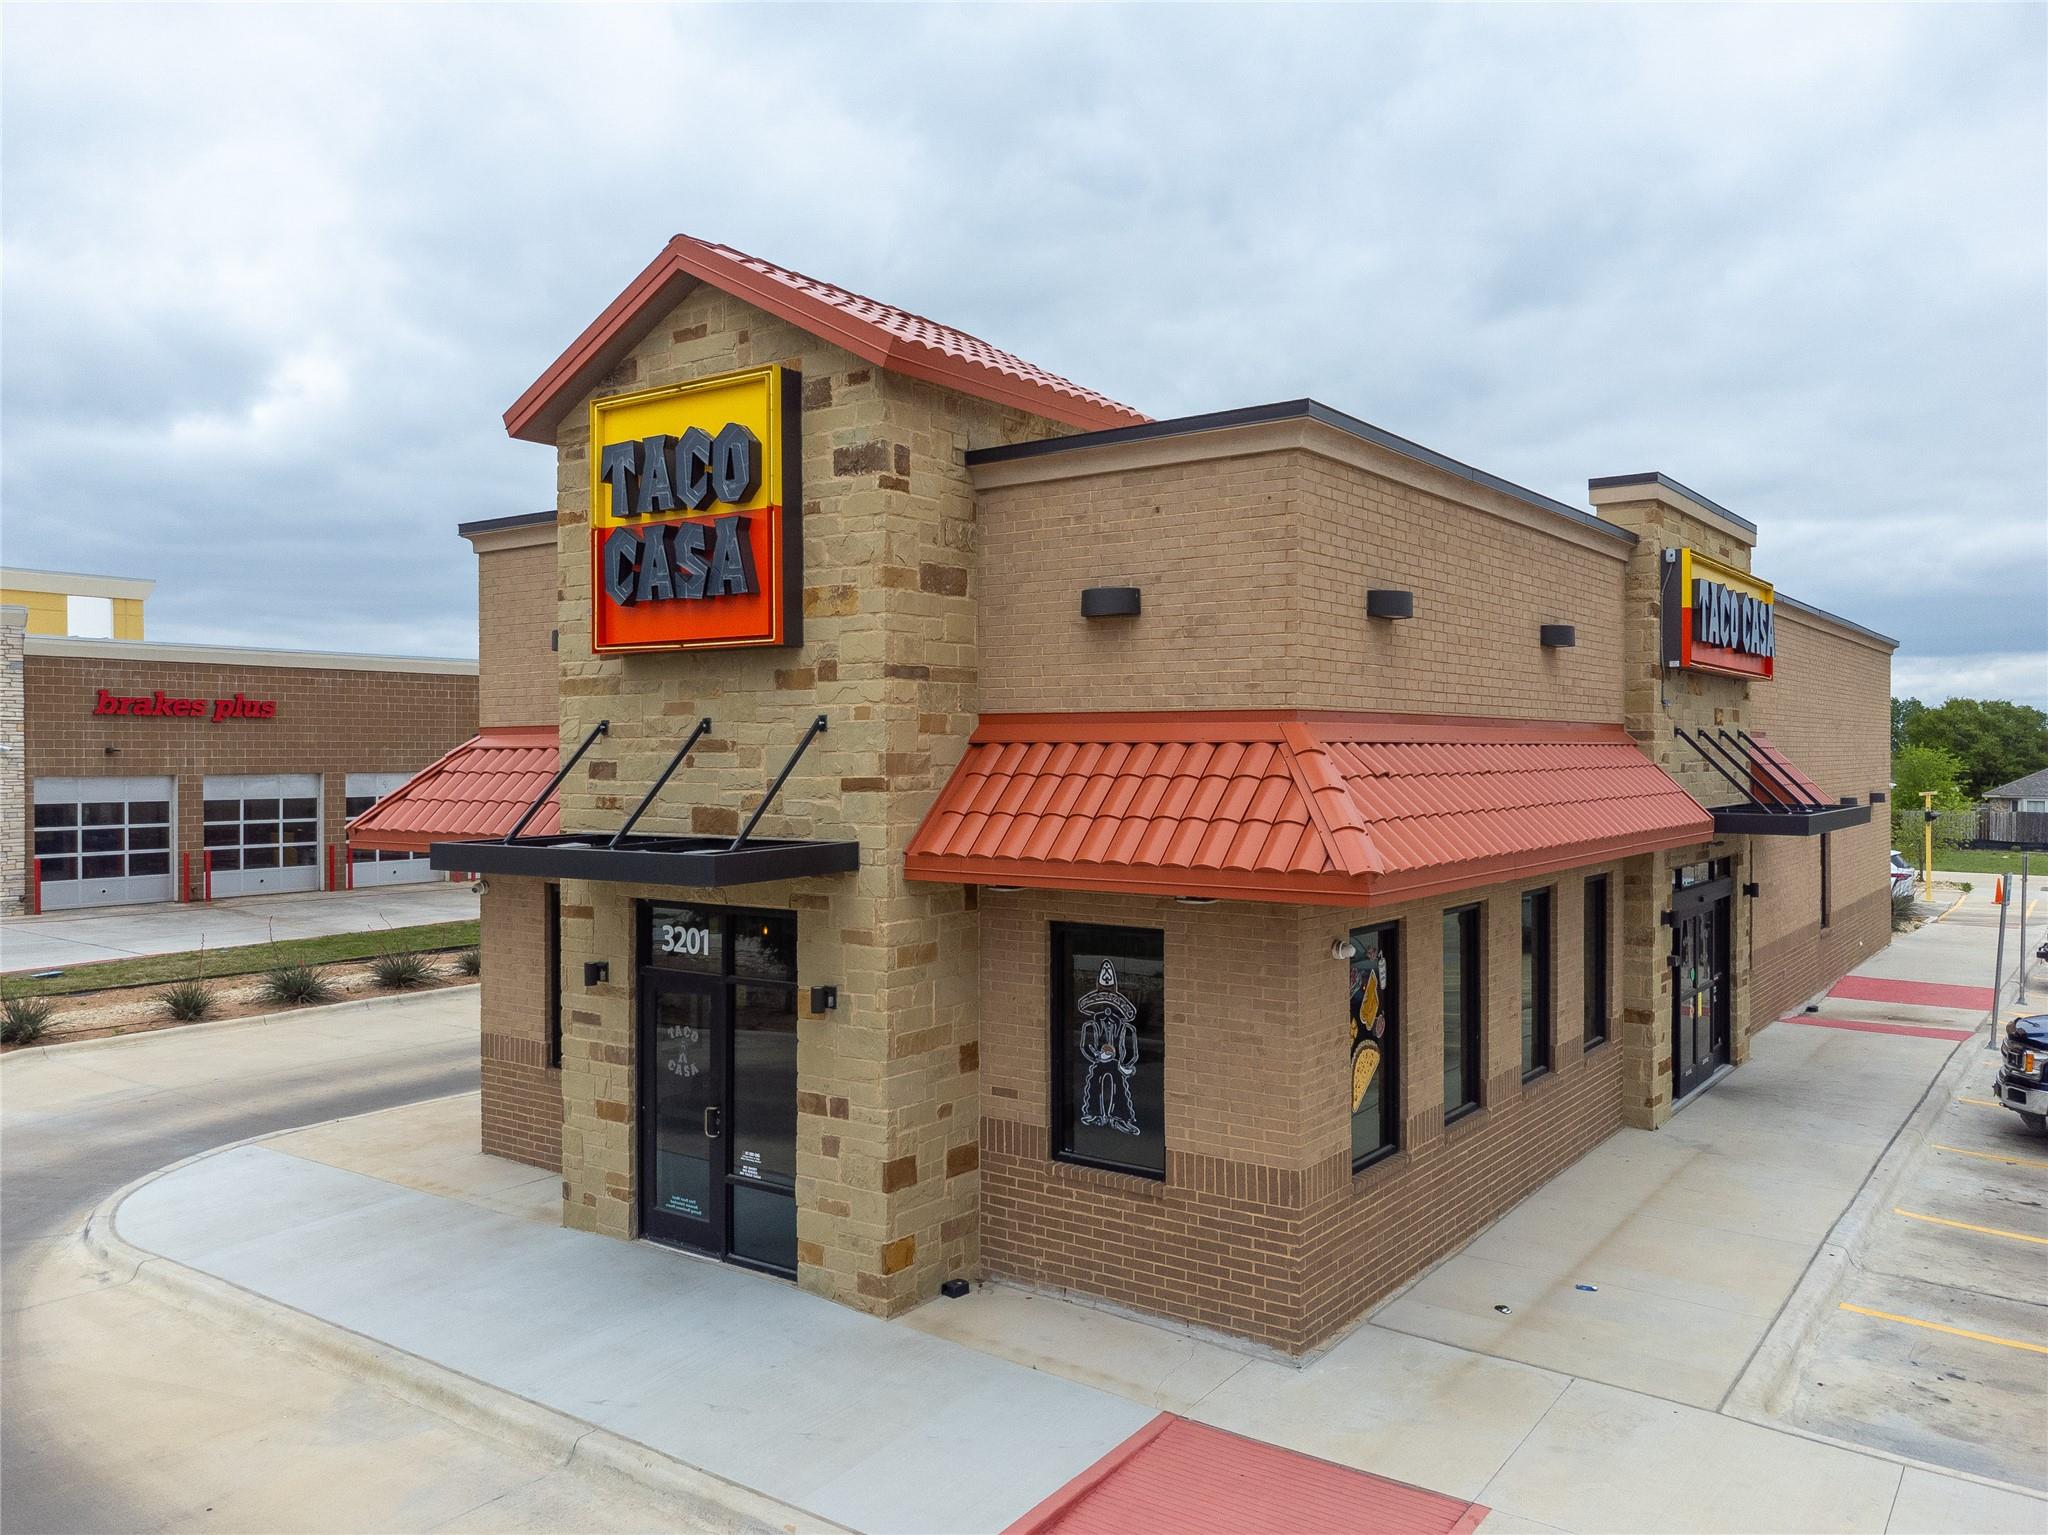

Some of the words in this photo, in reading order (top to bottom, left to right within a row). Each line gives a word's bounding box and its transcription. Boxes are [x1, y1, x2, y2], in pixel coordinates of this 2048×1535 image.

[601, 422, 761, 518] TACO
[604, 516, 760, 607] CASA
[1698, 578, 1739, 649] TACO
[1742, 592, 1776, 658] CASA
[93, 689, 208, 718] brakes
[212, 693, 277, 723] plus
[661, 924, 709, 956] 3201
[667, 1025, 699, 1043] TACO
[667, 1059, 700, 1077] CASA
